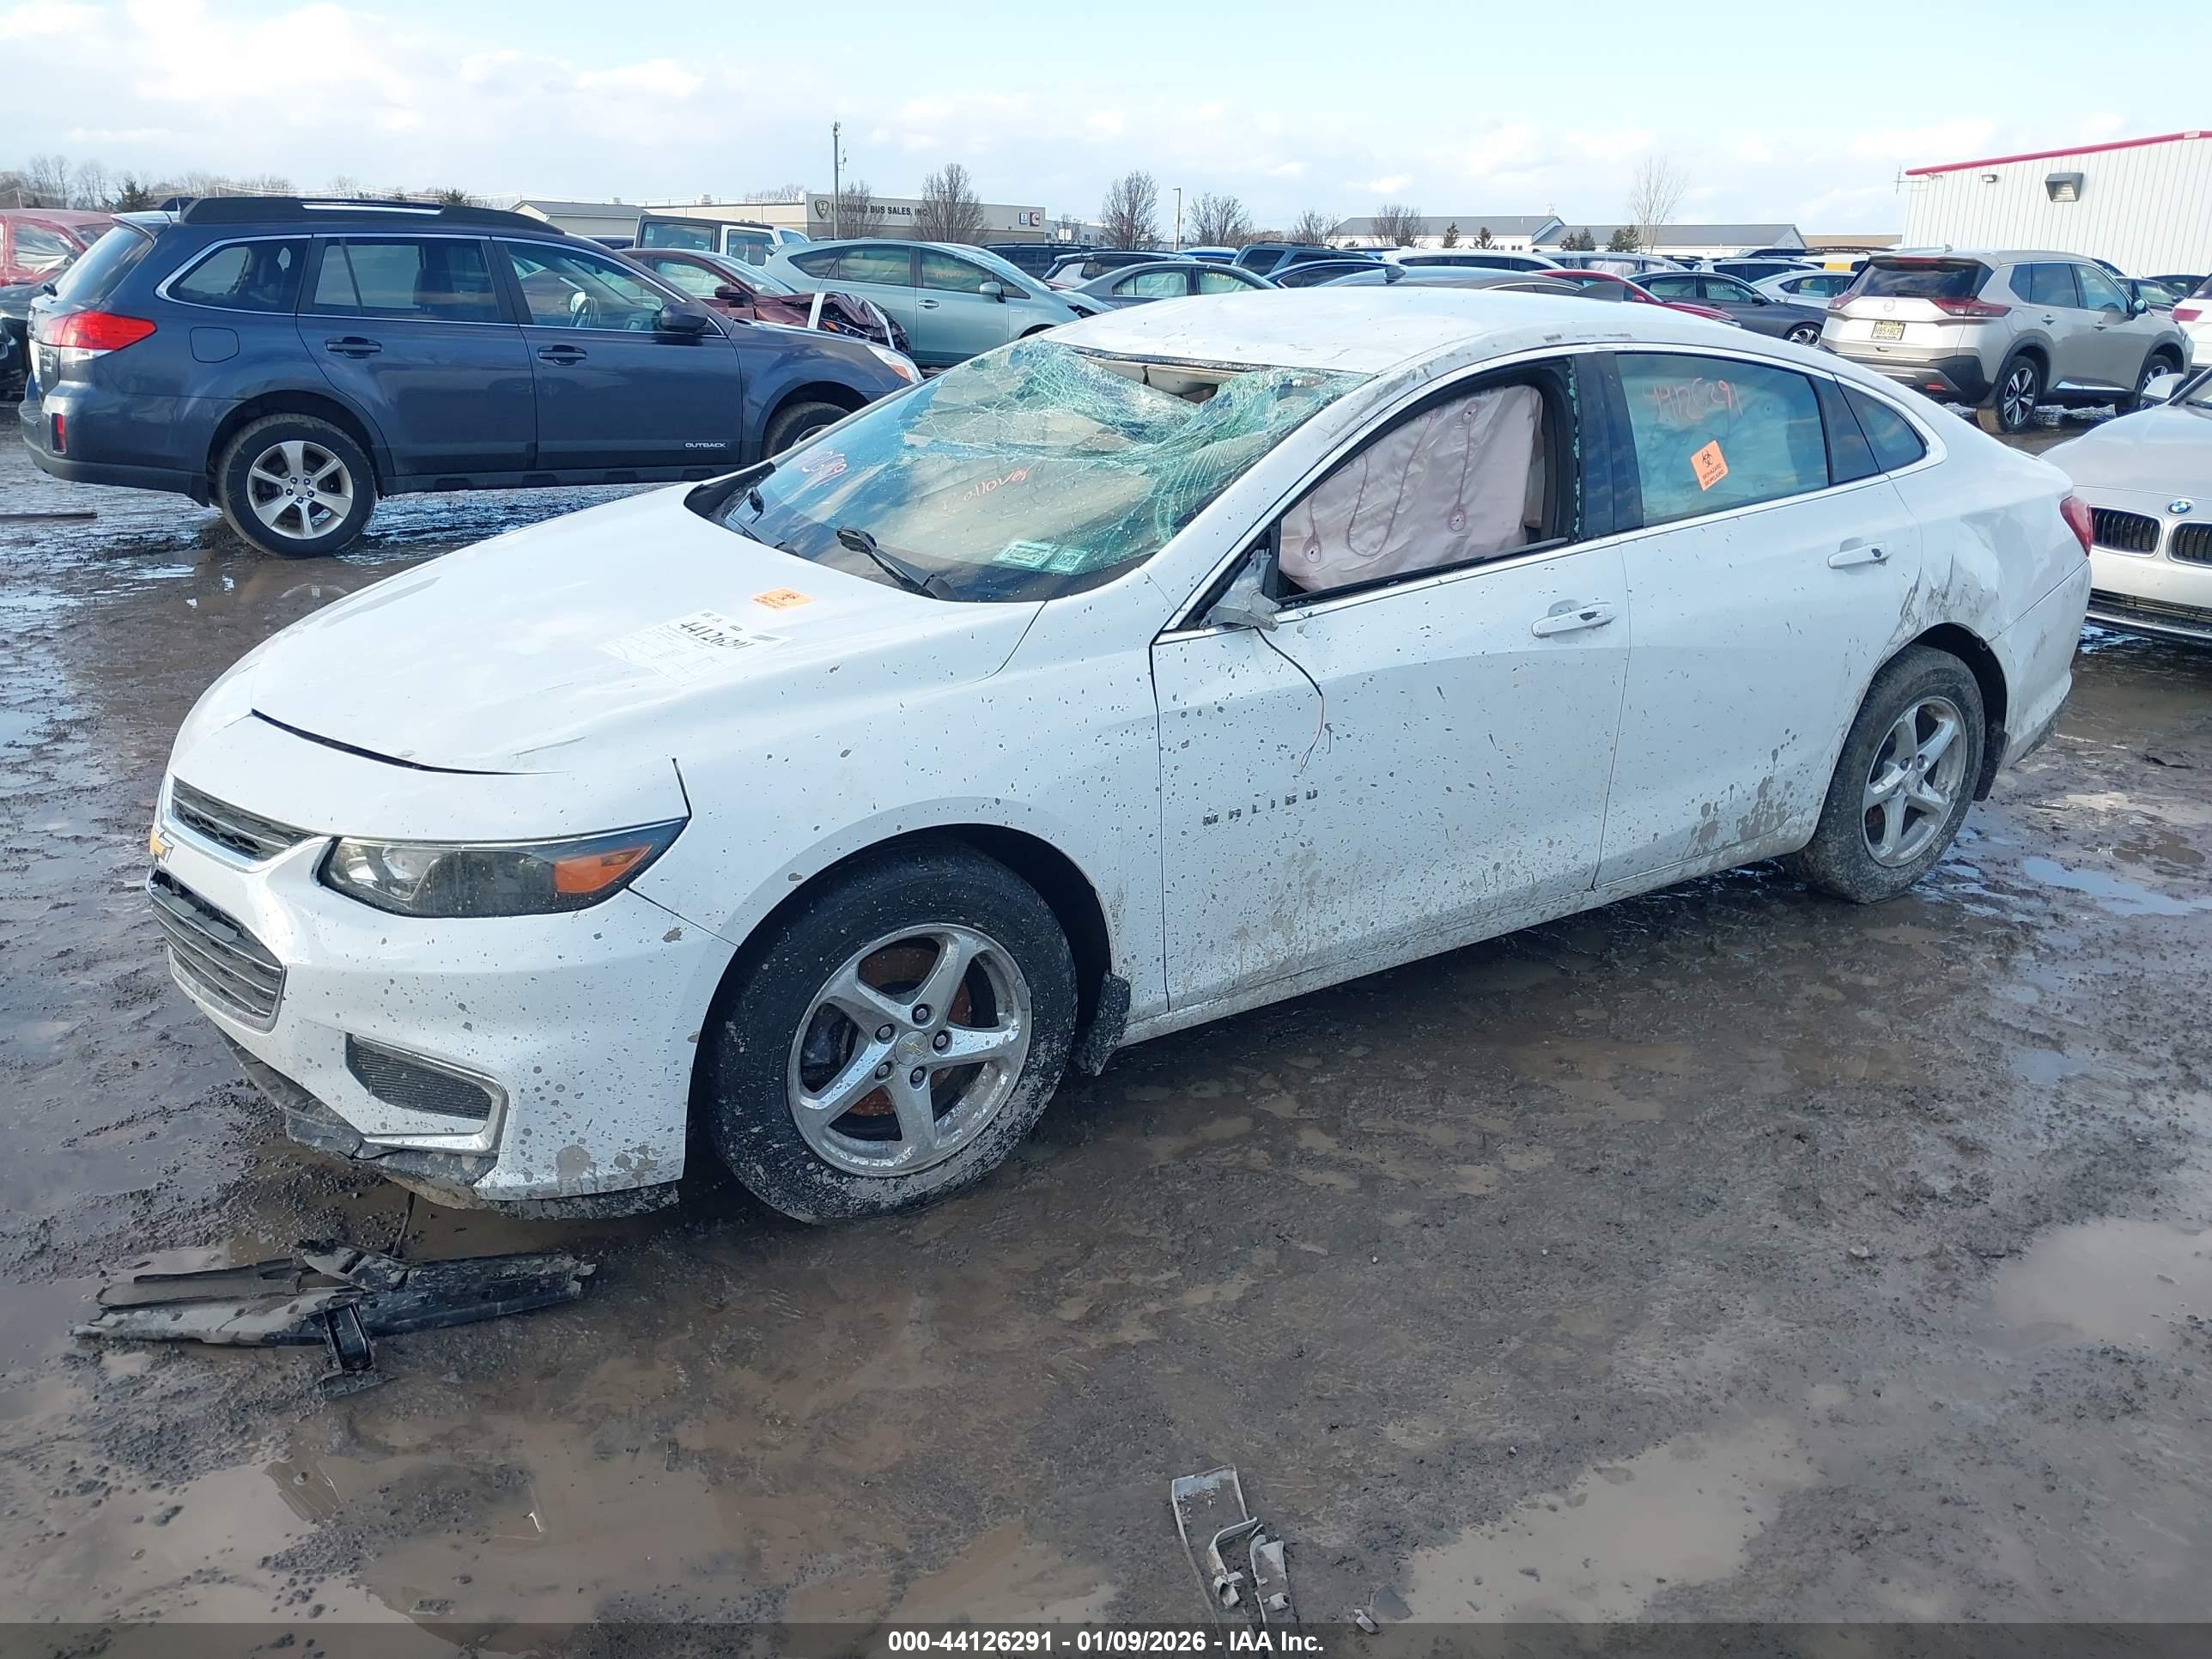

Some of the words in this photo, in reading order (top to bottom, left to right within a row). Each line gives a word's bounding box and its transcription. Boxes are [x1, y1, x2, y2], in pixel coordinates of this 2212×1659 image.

[870, 205, 885, 215] BUS
[887, 207, 913, 216] SALES,
[1202, 787, 1319, 826] MALIBU
